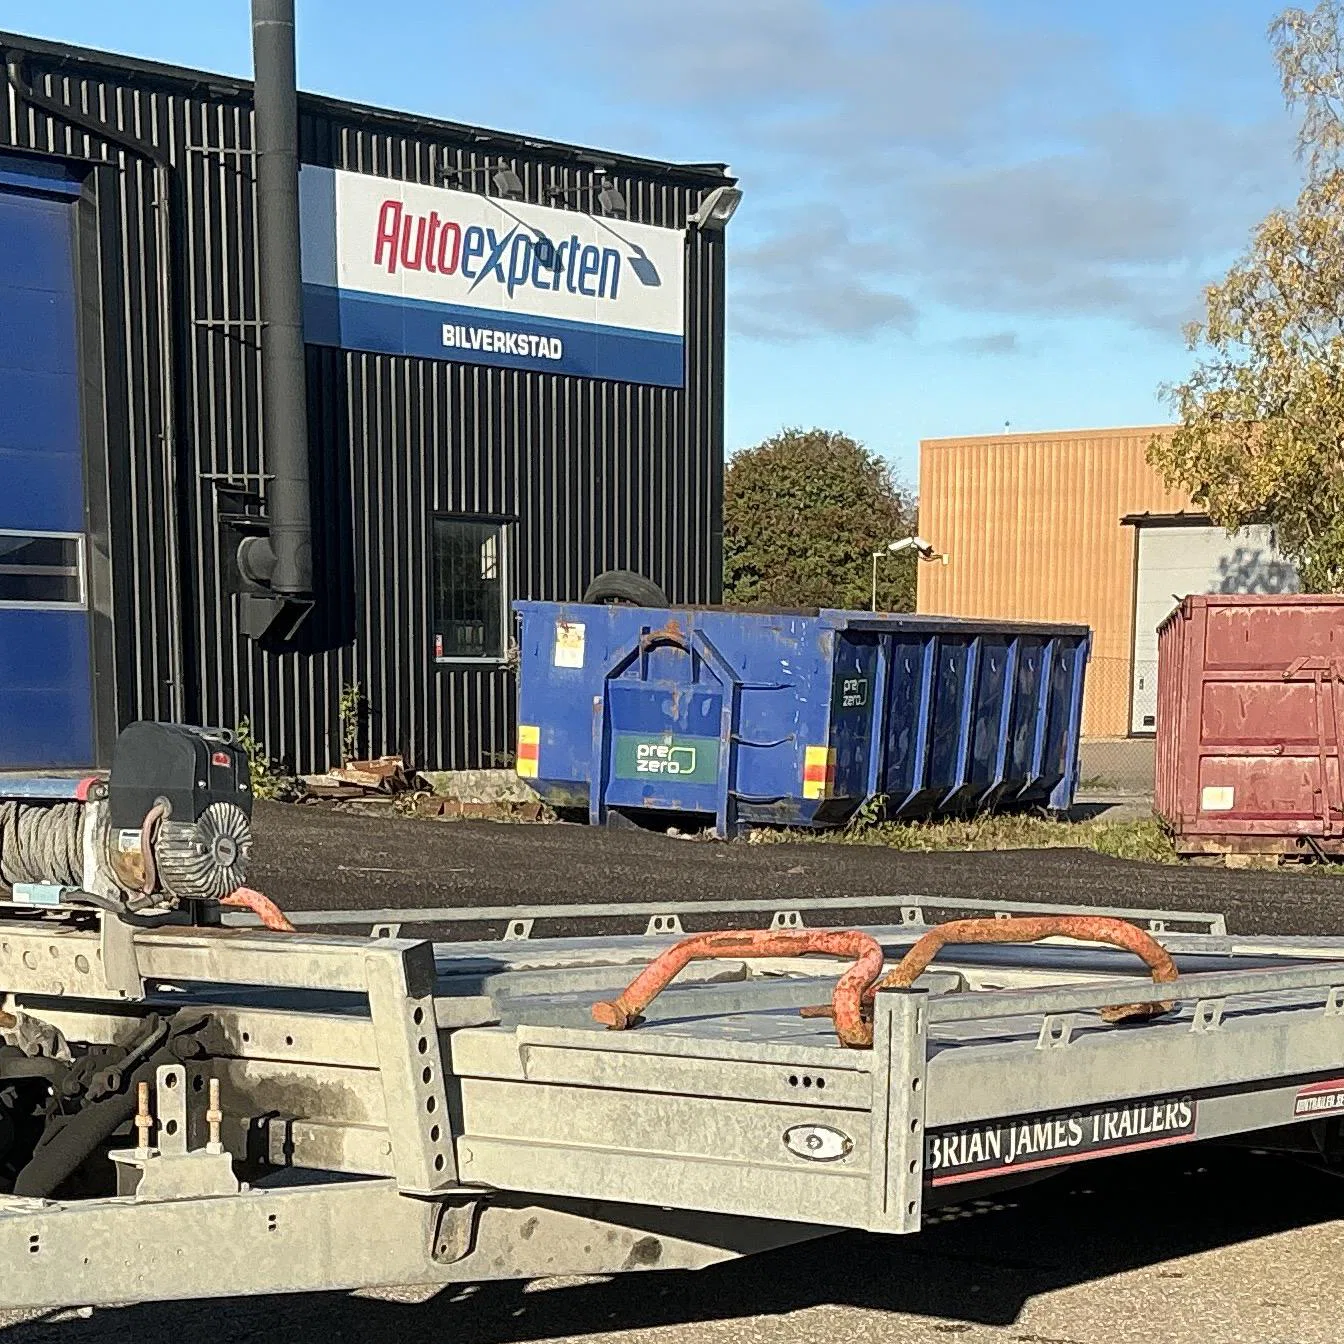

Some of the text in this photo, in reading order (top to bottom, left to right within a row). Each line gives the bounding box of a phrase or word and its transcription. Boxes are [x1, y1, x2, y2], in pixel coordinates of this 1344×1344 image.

[374, 199, 621, 300] Autoexperten
[442, 323, 562, 360] BILVERKSTAD
[636, 759, 680, 774] zero
[637, 744, 669, 760] pre
[925, 1096, 1193, 1169] BRIAN JAMES TRAILERS
